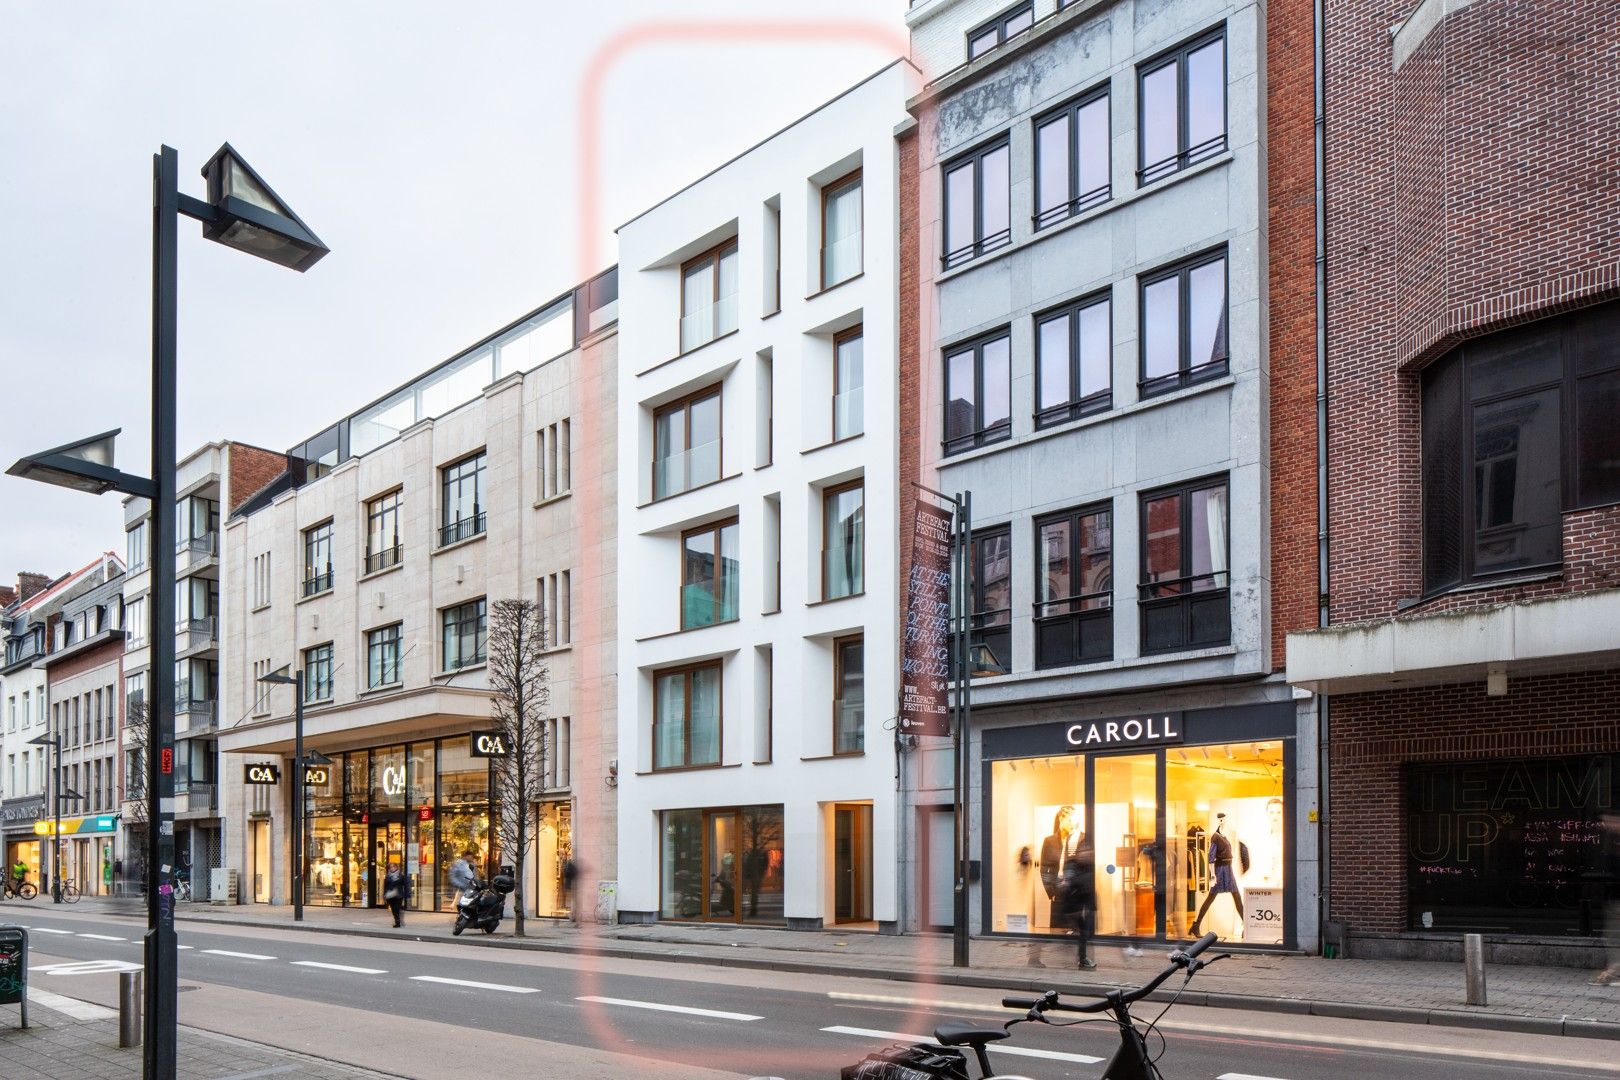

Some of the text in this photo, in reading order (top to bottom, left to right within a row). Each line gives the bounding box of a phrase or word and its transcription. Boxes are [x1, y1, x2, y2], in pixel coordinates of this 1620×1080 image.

[917, 511, 950, 532] ARTEFACT
[916, 521, 949, 543] FESTIVAL
[910, 597, 949, 617] POINT
[923, 645, 948, 661] ING
[903, 658, 949, 677] WORLD
[903, 703, 947, 714] FESTIVAL.BE
[1067, 716, 1178, 744] CAROLL
[477, 735, 506, 754] C&A
[249, 767, 275, 782] C&A
[383, 764, 407, 796] C&A
[1414, 754, 1612, 812] TEAM
[1250, 909, 1281, 922] -30%
